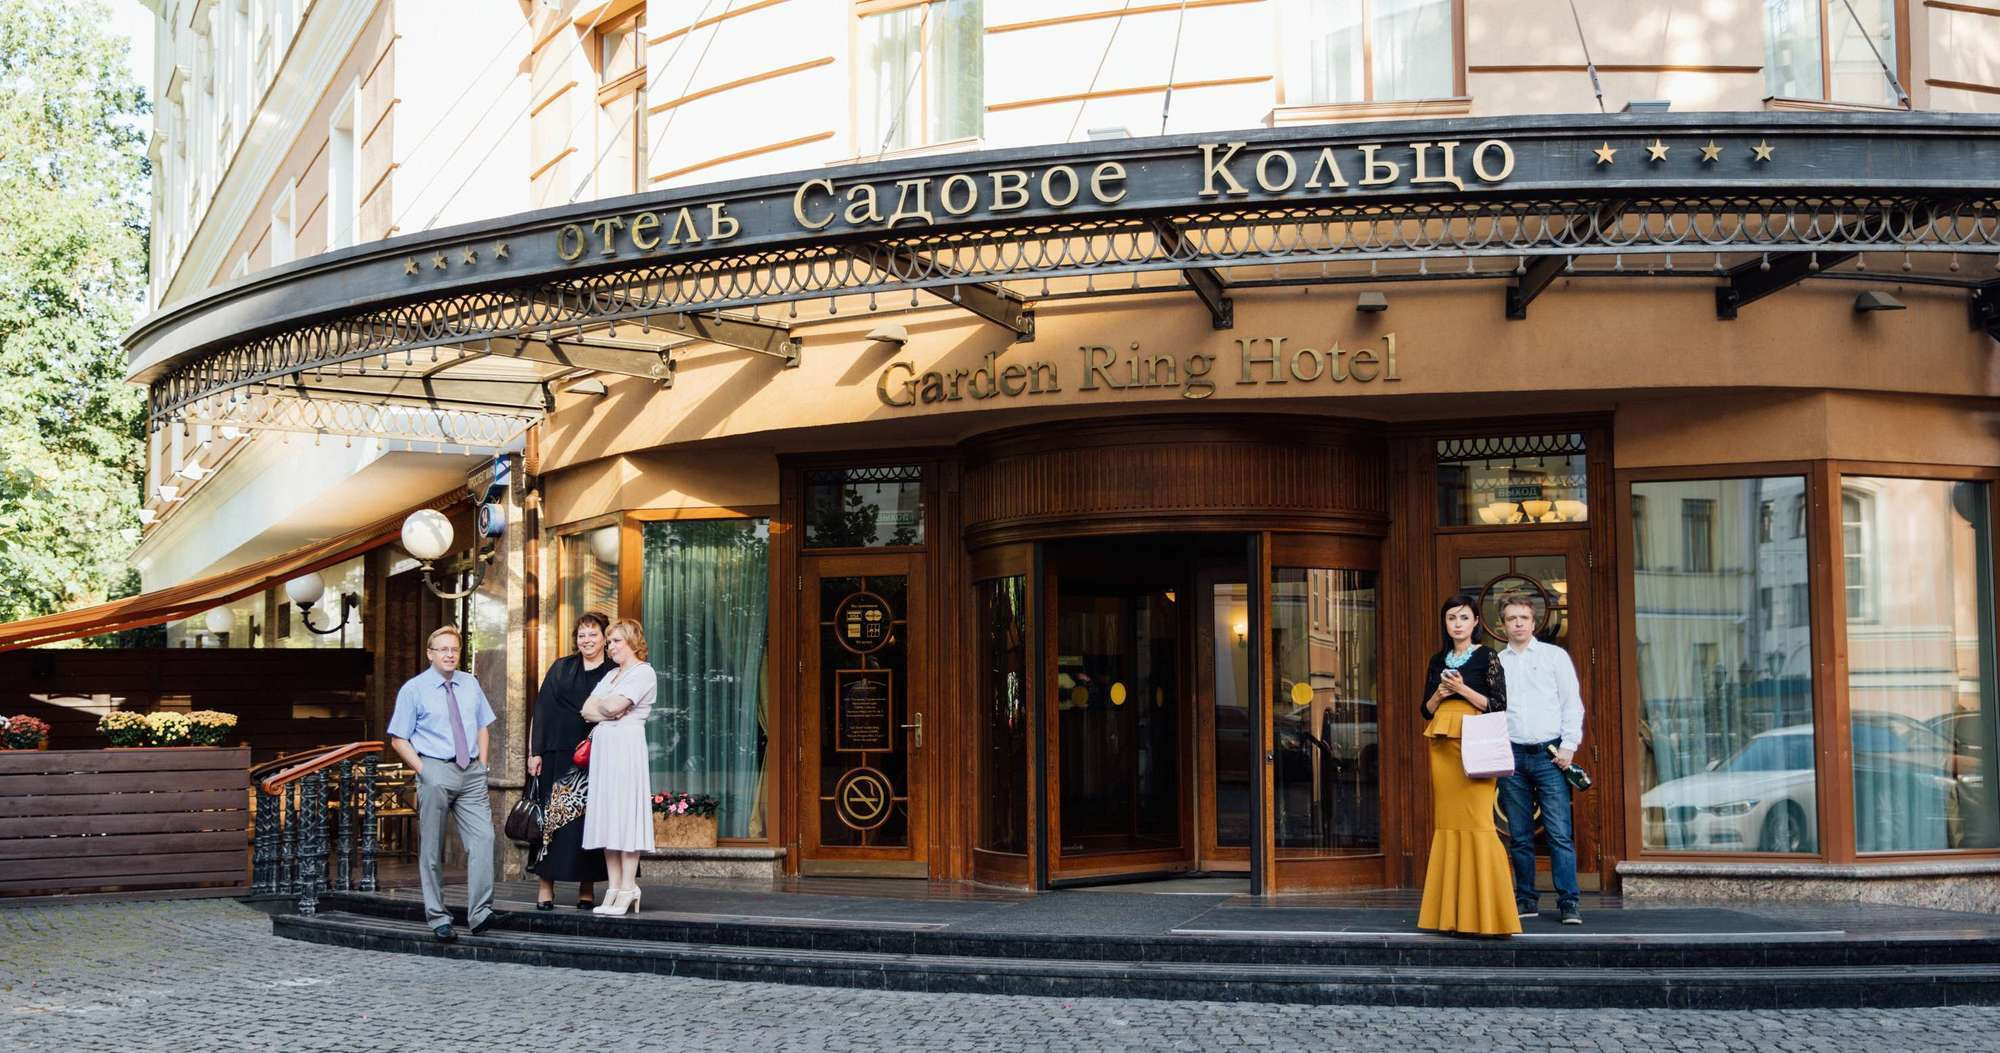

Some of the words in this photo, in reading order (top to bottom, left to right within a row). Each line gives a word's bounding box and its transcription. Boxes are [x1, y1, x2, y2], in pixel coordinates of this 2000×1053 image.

[557, 202, 741, 261] отель
[793, 161, 1128, 230] Садовое
[1198, 139, 1515, 196] Кольцо
[876, 351, 1062, 408] Garden
[1079, 342, 1216, 399] Ring
[1235, 332, 1402, 385] Hotel
[1498, 487, 1537, 497] ВЫХОД
